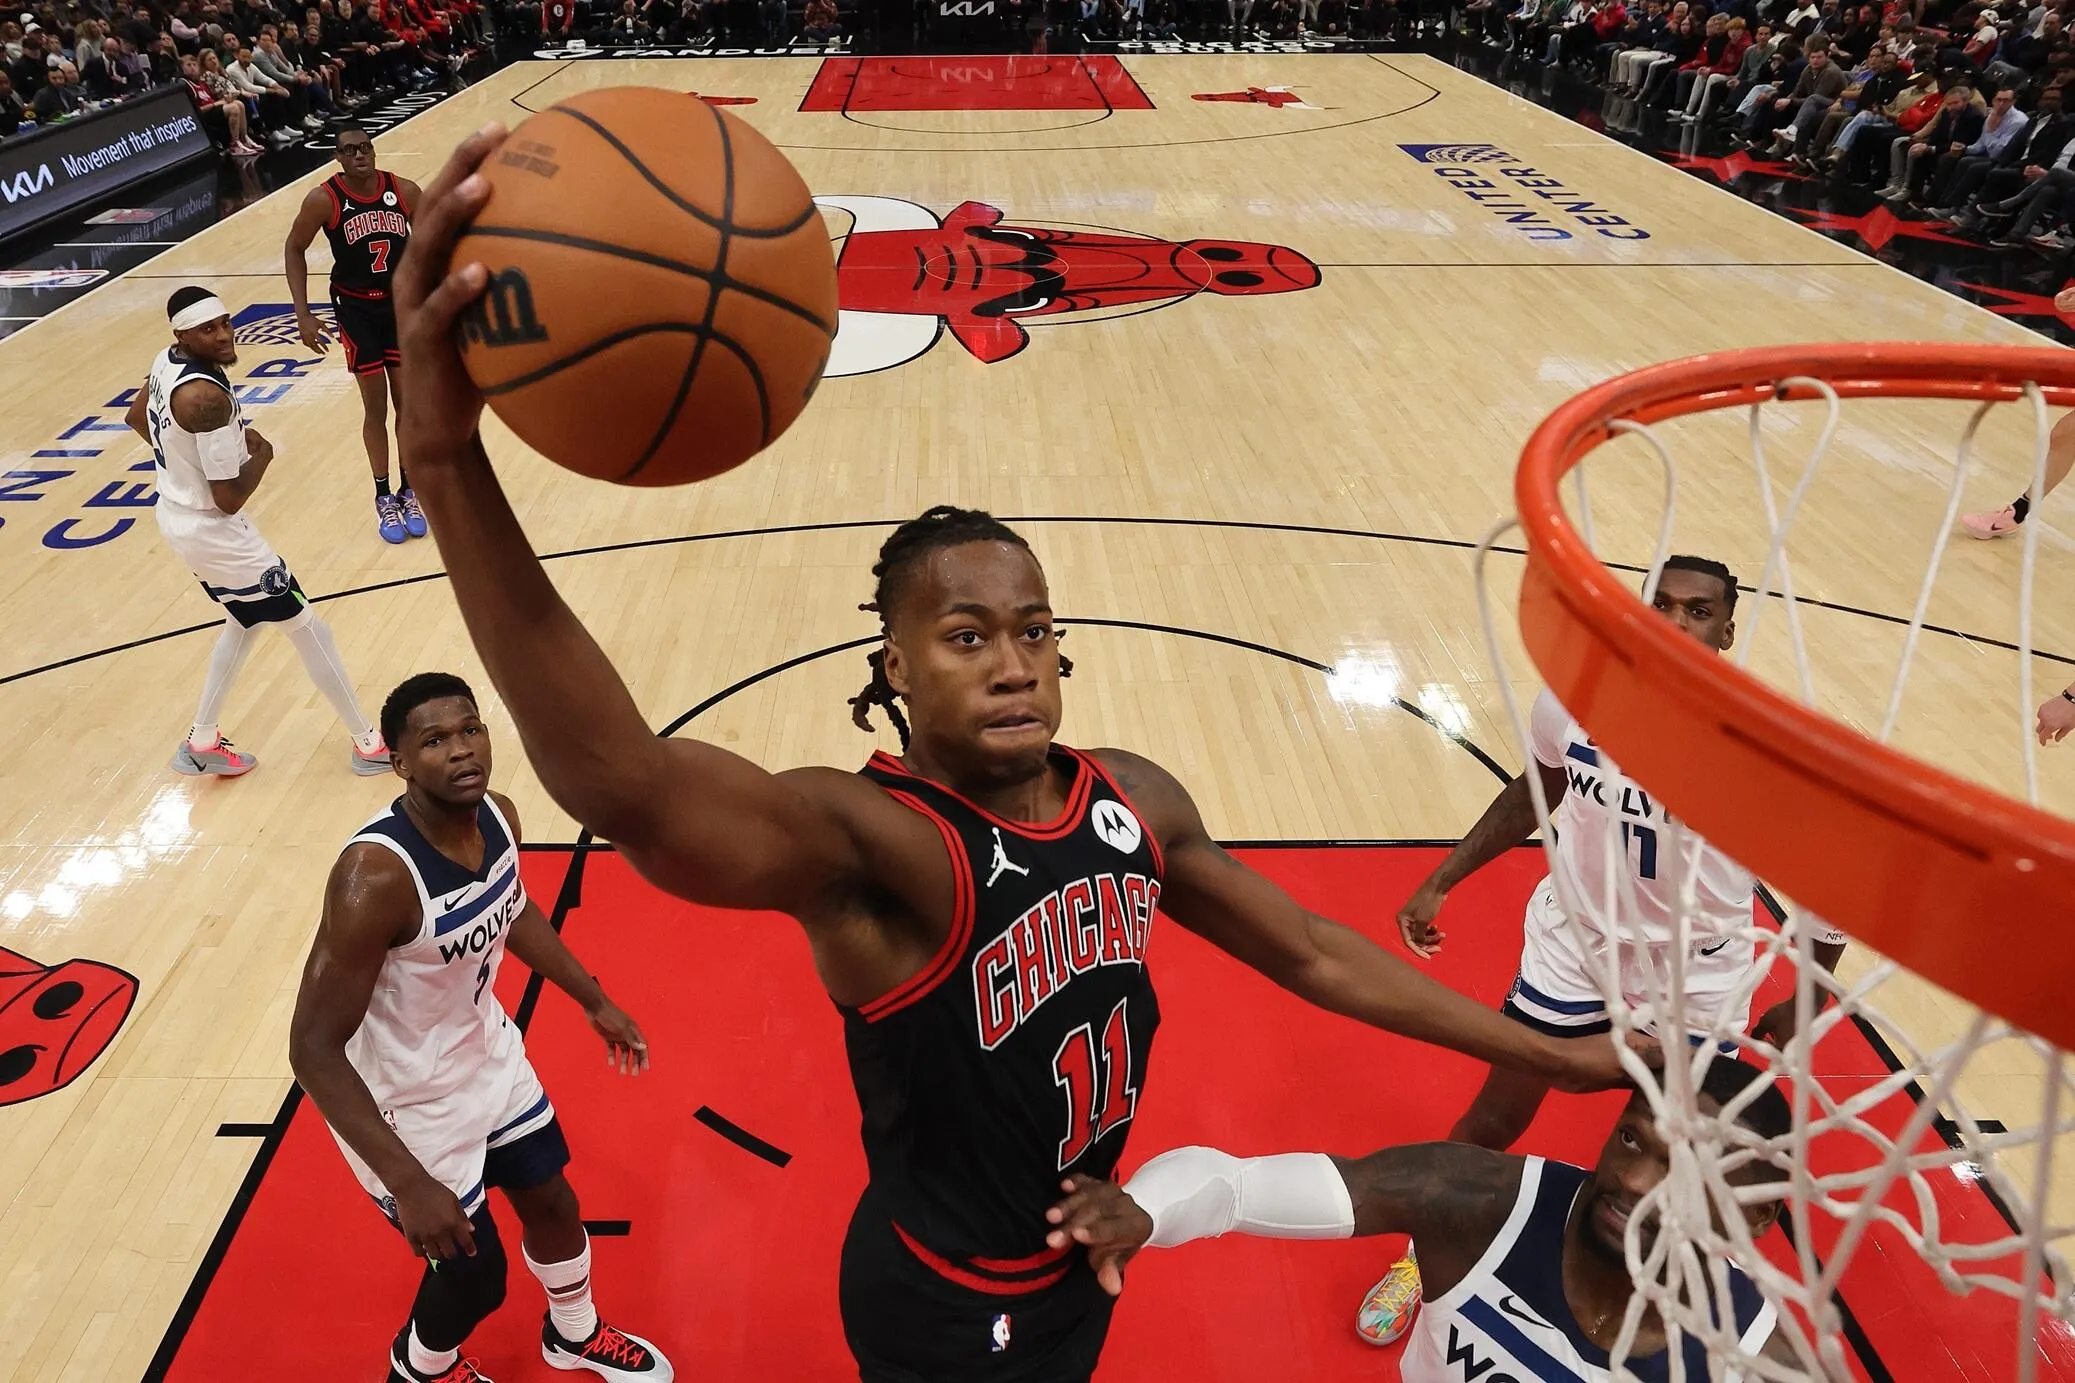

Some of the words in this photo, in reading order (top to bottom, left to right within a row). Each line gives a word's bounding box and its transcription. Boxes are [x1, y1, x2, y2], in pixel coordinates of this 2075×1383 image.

[612, 48, 852, 57] FANDUEL
[61, 137, 132, 178] Movement
[129, 128, 155, 154] that
[152, 115, 197, 143] inspires
[304, 91, 448, 149] CLAMOS
[343, 210, 406, 245] CHICAGO
[1433, 167, 1573, 240] UNITED
[1500, 167, 1651, 240] CENTER
[369, 240, 390, 273] 7
[972, 873, 1161, 1051] CHICAGO
[1052, 997, 1137, 1172] 11
